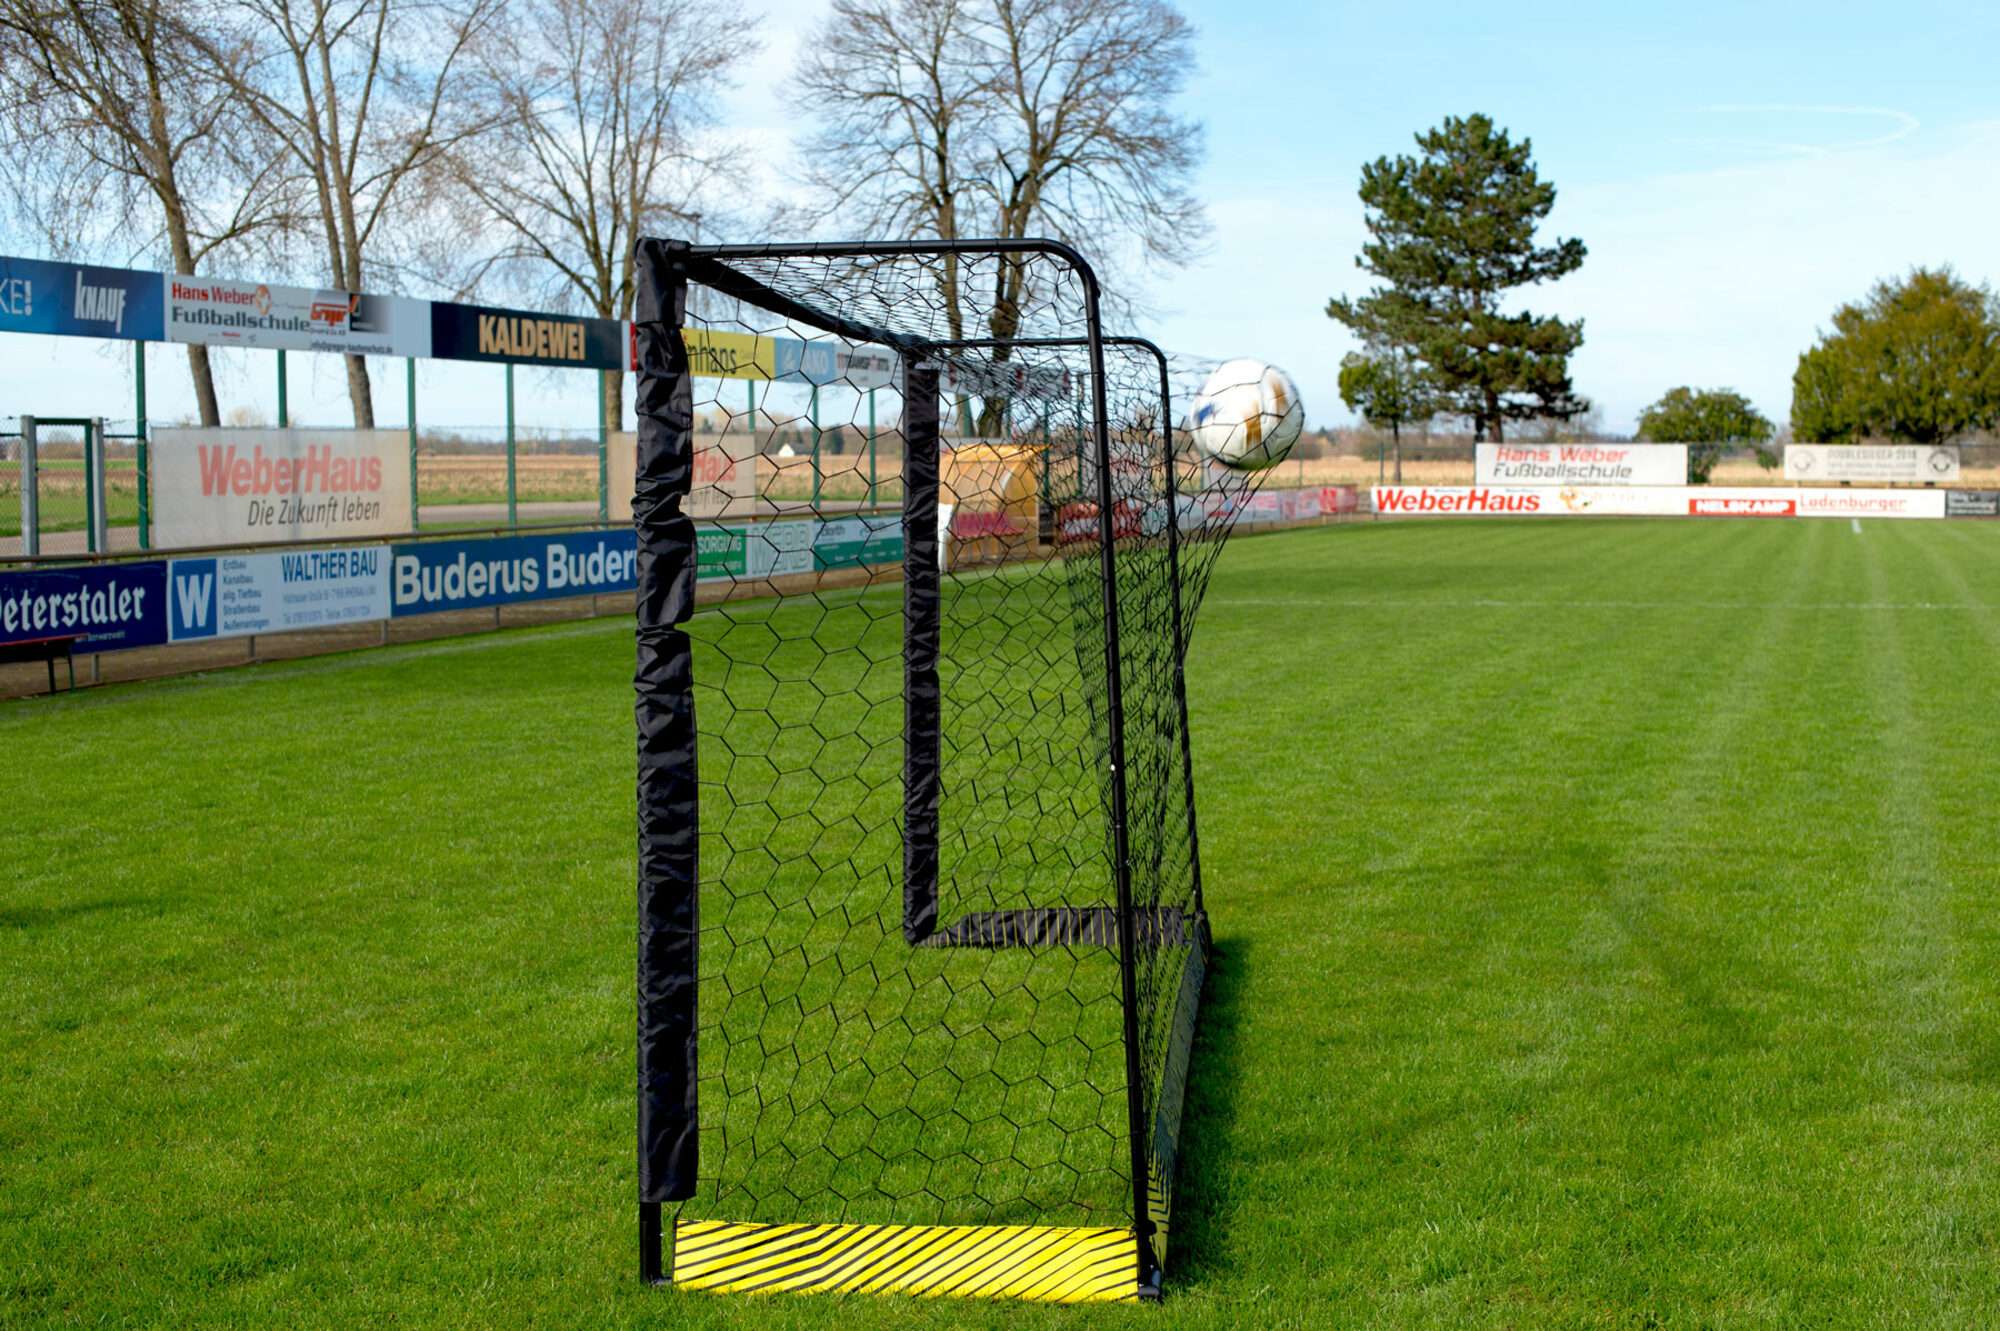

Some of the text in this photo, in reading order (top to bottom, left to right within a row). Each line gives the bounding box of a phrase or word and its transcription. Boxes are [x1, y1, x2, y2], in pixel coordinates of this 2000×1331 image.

[172, 282, 256, 304] Hans Weber
[172, 306, 311, 331] Fußballschule
[479, 314, 585, 360] KALDEWEI
[198, 445, 383, 496] WeberHaus
[1493, 463, 1633, 479] Fußballschule
[1496, 448, 1629, 462] Hans Weber
[248, 496, 380, 528] Die Zukunft leben
[1377, 489, 1541, 511] WeberHaus
[281, 549, 377, 582] WALTHER BAU
[396, 541, 640, 605] Buderus Buder
[0, 580, 145, 633] eterstaler
